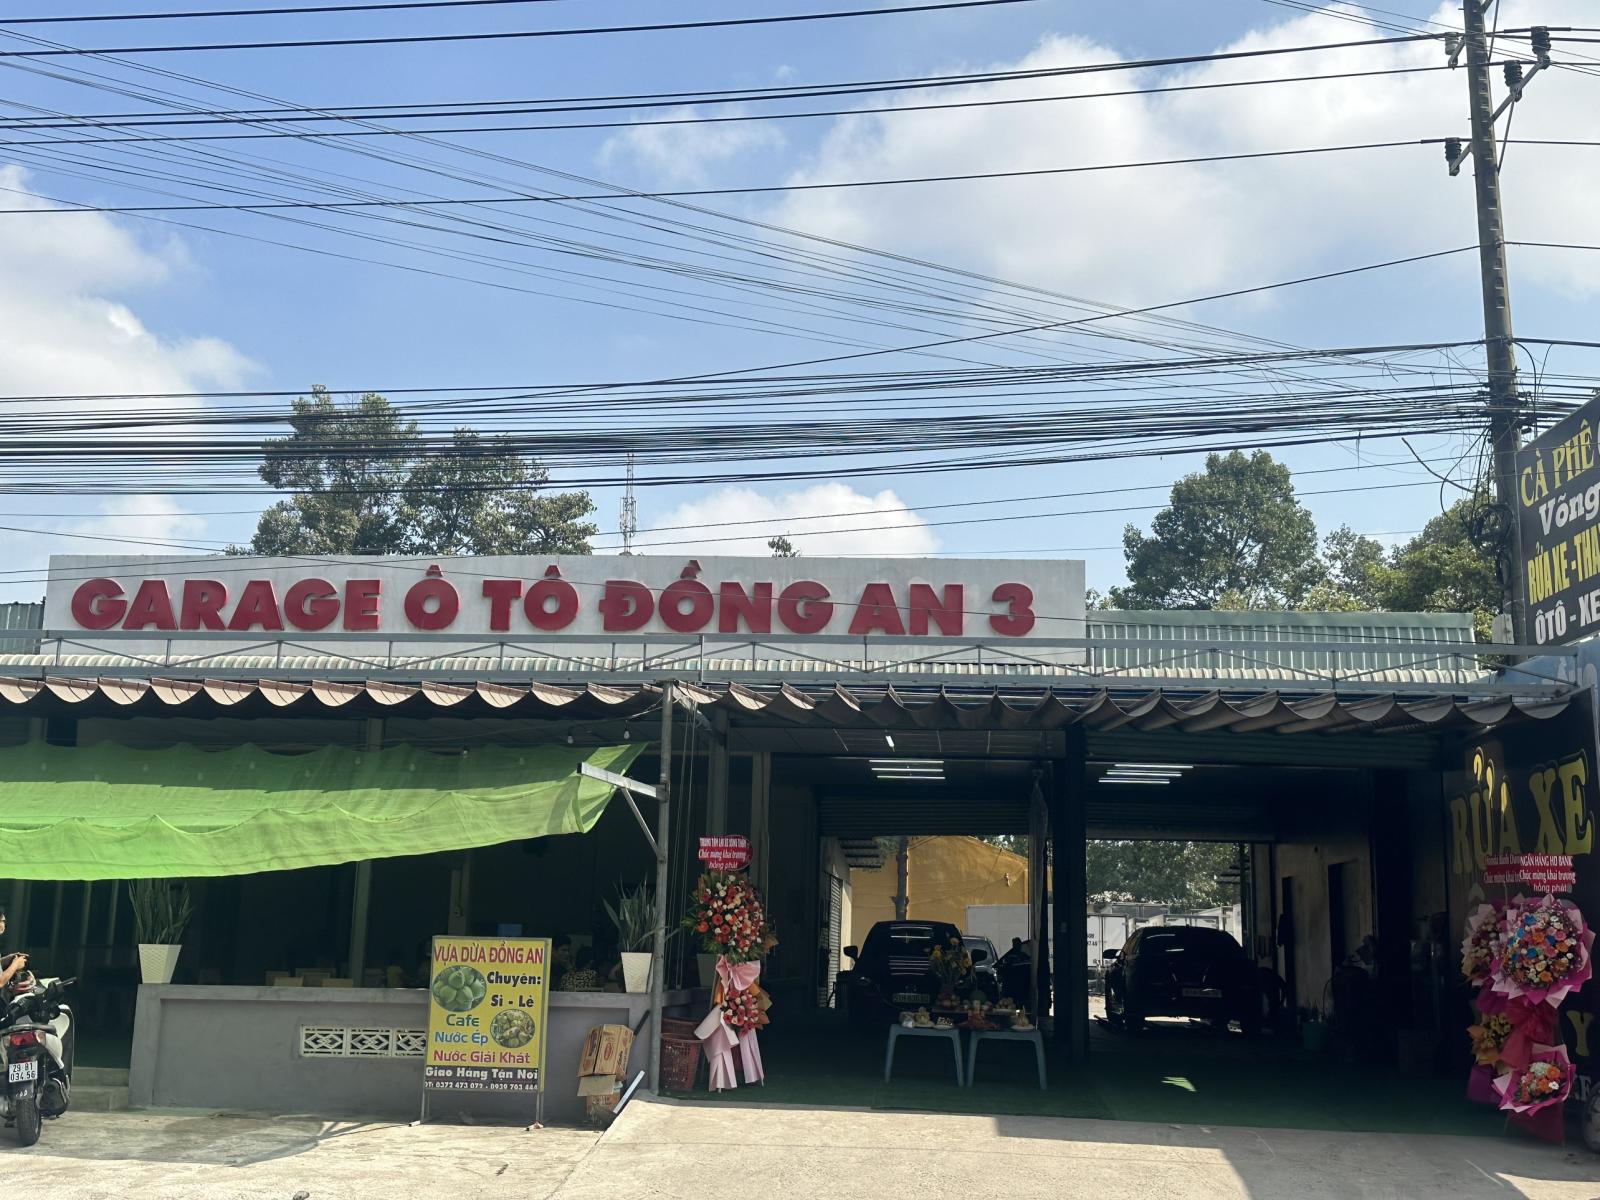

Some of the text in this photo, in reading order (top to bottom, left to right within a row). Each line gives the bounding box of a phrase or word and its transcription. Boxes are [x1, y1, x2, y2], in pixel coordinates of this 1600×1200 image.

[1521, 448, 1549, 508] CÀ
[1552, 419, 1594, 488] PHÊ
[1552, 541, 1571, 594] XE
[71, 578, 381, 631] GARAGE
[404, 564, 460, 631] Ô
[483, 564, 579, 631] TÔ
[848, 583, 963, 635] AN
[990, 583, 1035, 636] 3
[1450, 751, 1592, 874] RỬA XE
[1519, 870, 1531, 880] Chúc
[1547, 870, 1558, 880] khai
[461, 942, 486, 963] DỪA
[526, 947, 544, 964] AN
[446, 1014, 480, 1027] Cafe
[435, 1029, 488, 1046] Nước Ép
[433, 1050, 466, 1062] Nước
[500, 1051, 530, 1064] Khát
[425, 1066, 452, 1077] Giao
